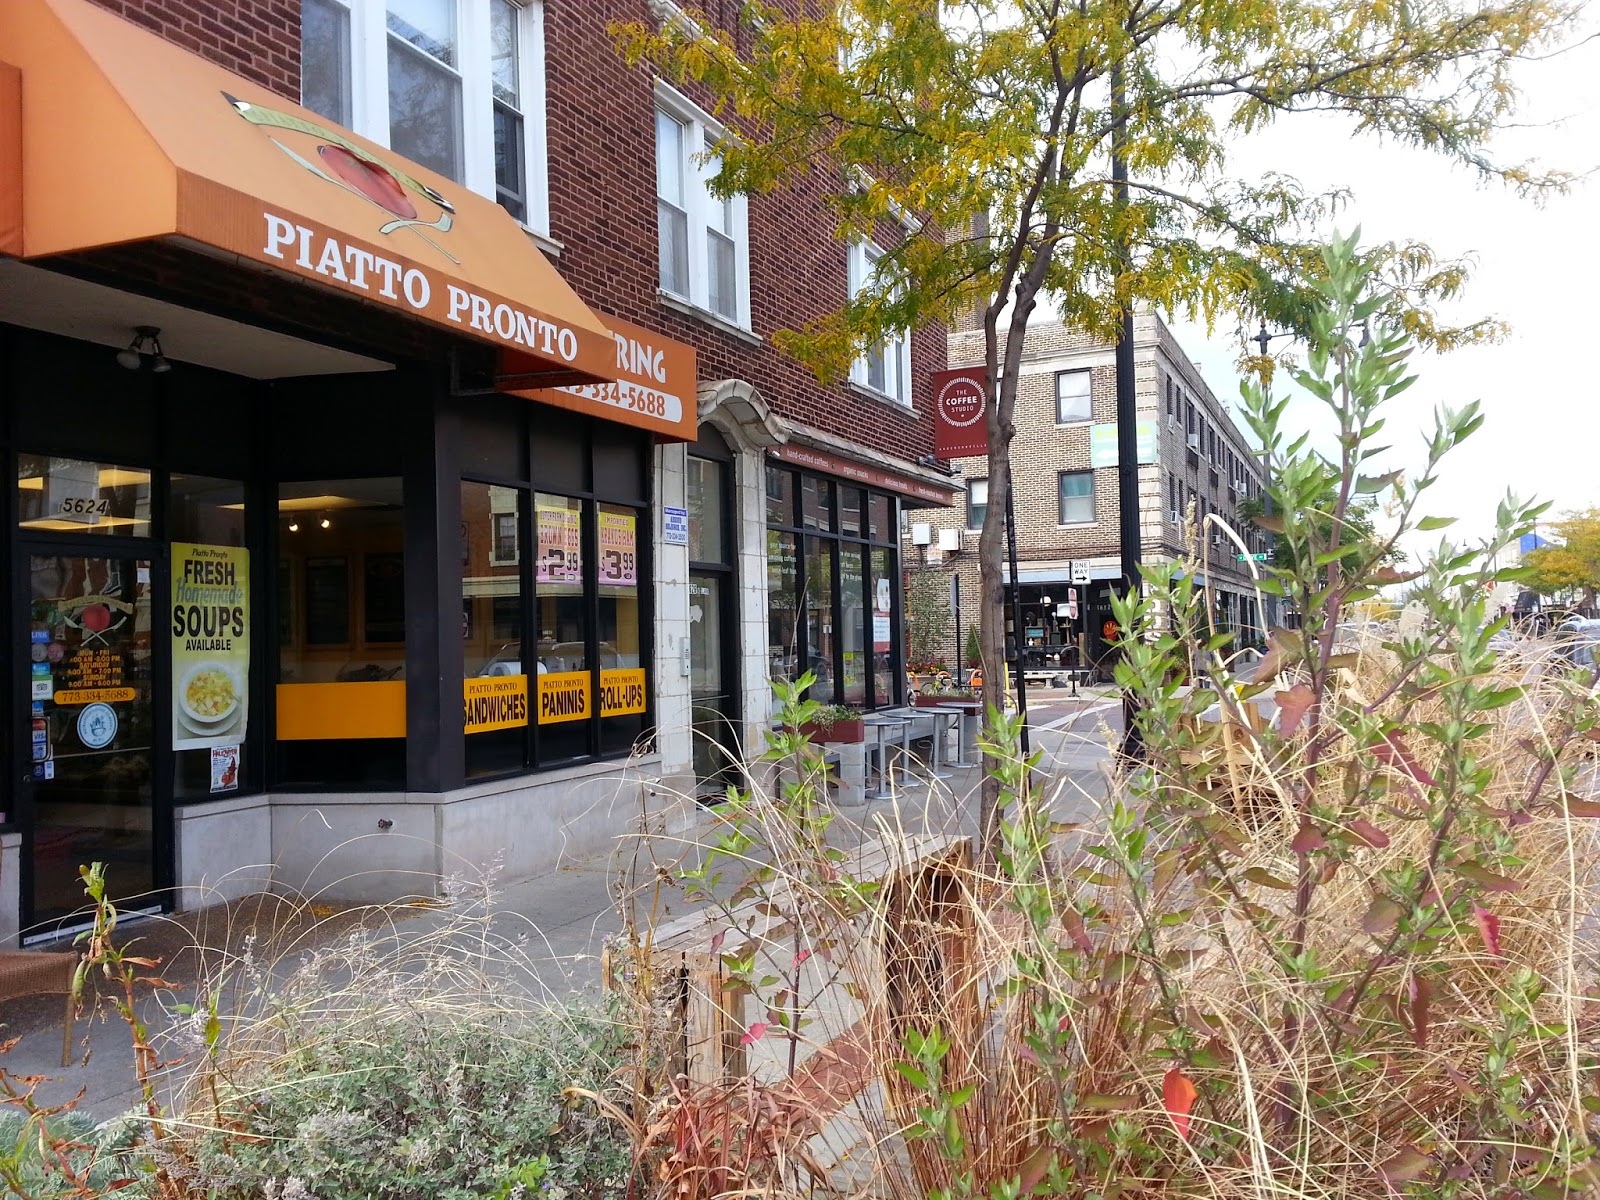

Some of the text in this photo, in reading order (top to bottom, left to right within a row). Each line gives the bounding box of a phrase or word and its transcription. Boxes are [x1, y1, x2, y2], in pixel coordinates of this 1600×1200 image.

[263, 212, 578, 362] PIATTO PRONTO
[609, 331, 666, 384] RING
[946, 396, 978, 405] COFFEE
[951, 405, 974, 413] STUDIO
[63, 498, 108, 514] 5624
[192, 548, 228, 559] Piatto Pronto
[184, 559, 235, 586] FRESH
[176, 577, 243, 605] Homemade
[173, 604, 244, 637] SOUPS
[185, 639, 231, 651] AVAILABLE
[79, 661, 110, 669] SATURDAY
[543, 678, 584, 689] PIATTO PRONTO
[603, 675, 639, 685] PIATTO PRONTO
[469, 682, 518, 694] PIATTO PRONTO
[62, 690, 129, 702] 773-334-5688
[600, 684, 643, 711] ROLL-UPS
[541, 688, 585, 718] PANINIS
